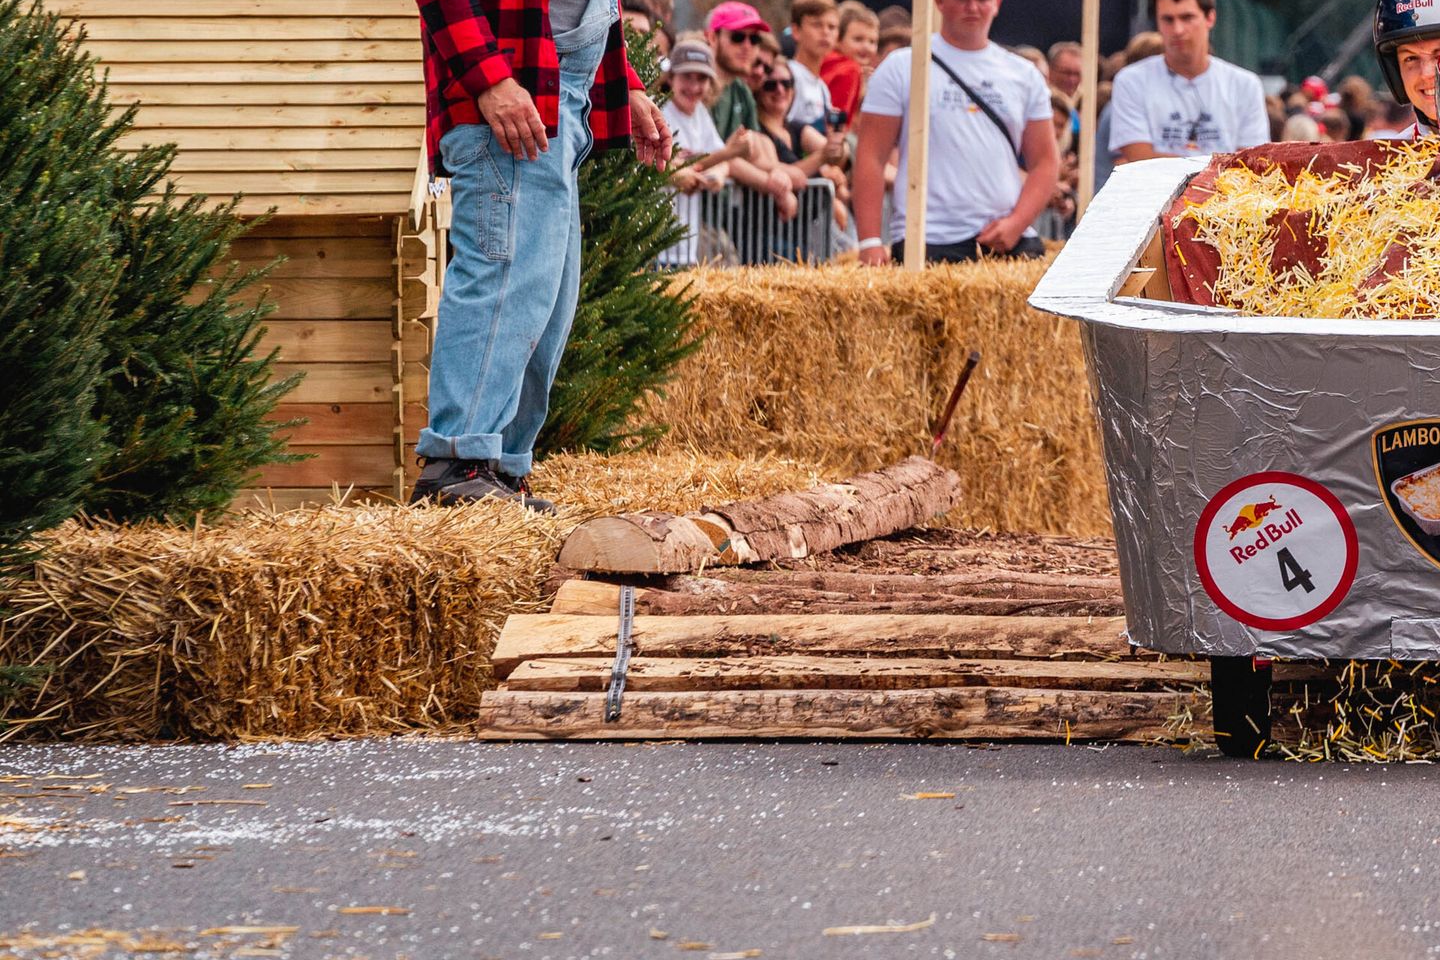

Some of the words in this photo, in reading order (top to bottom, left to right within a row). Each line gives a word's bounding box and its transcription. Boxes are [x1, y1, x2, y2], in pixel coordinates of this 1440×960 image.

[1396, 0, 1415, 13] Red
[1229, 538, 1269, 564] Red
[1267, 508, 1303, 542] Bull
[1276, 547, 1316, 594] 4
